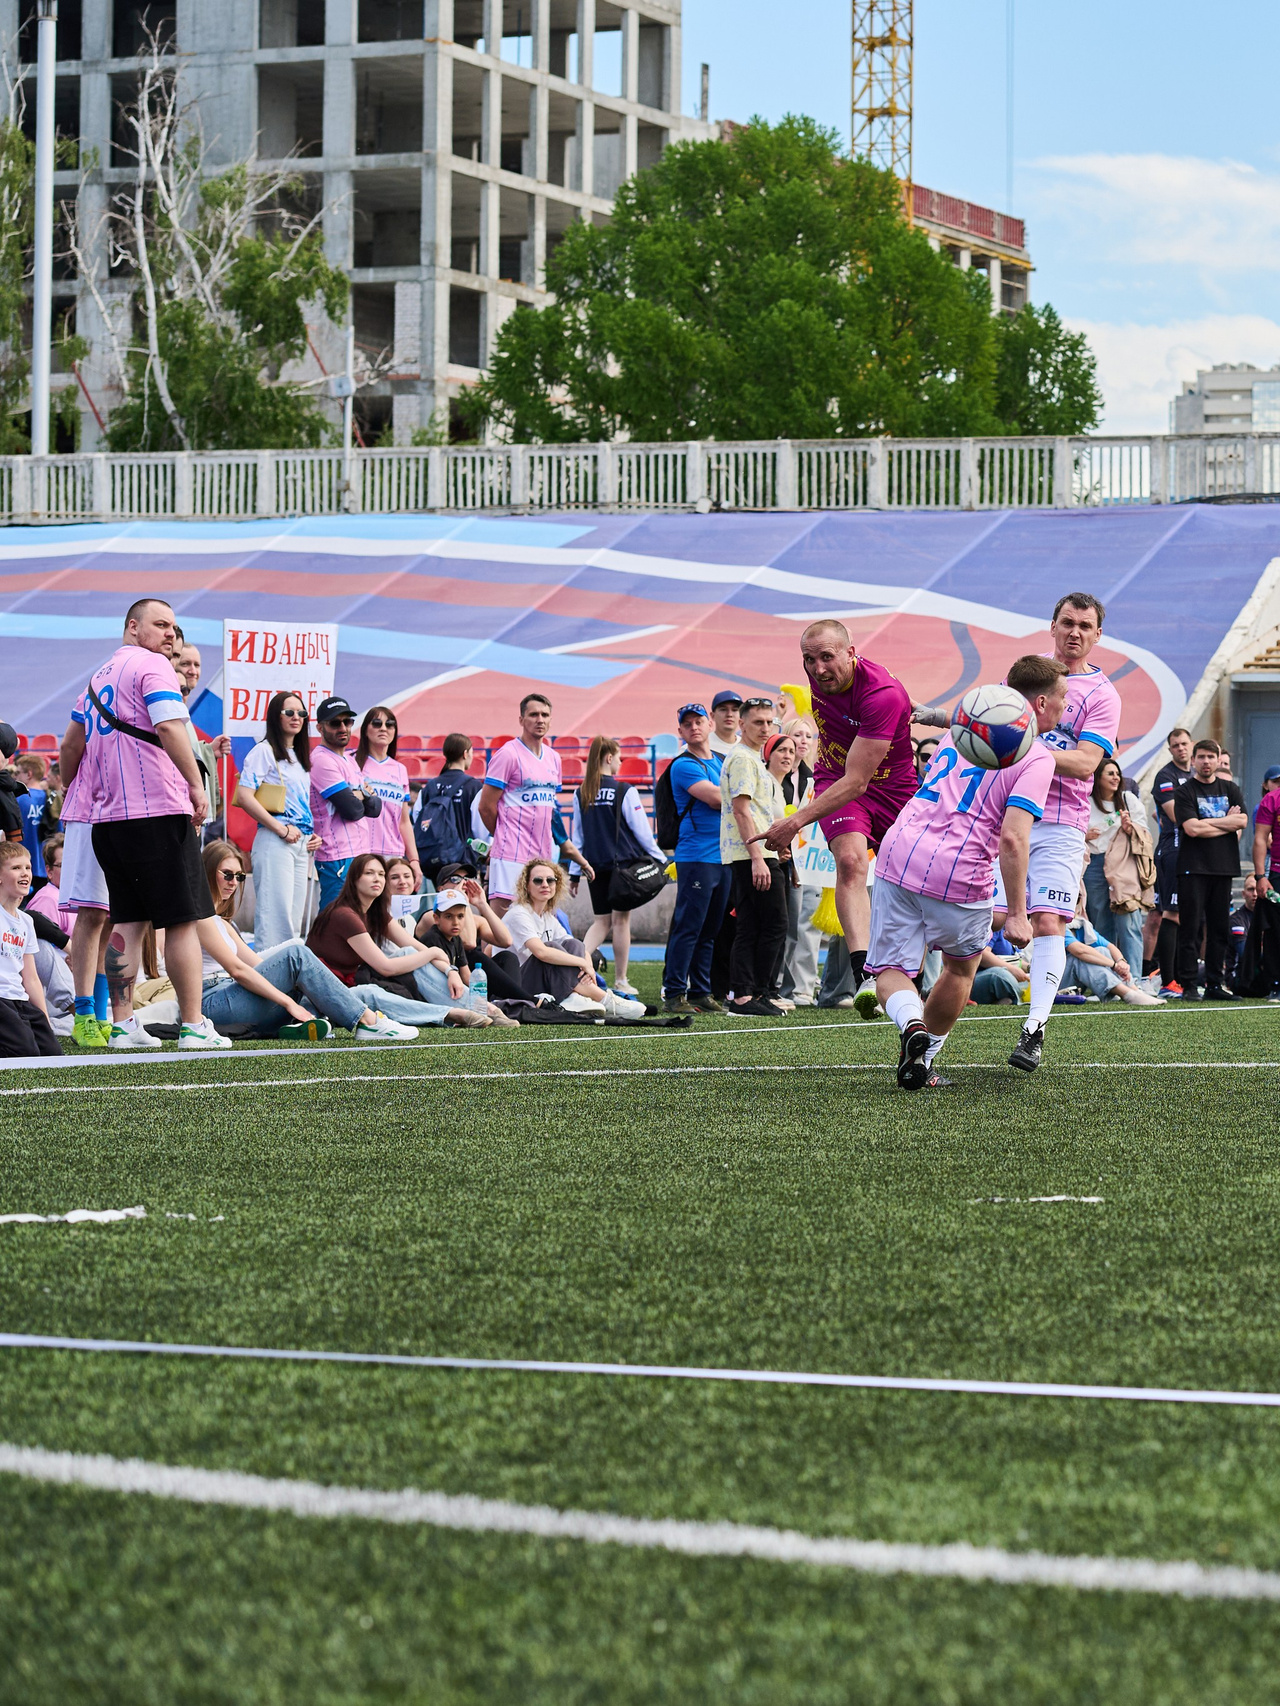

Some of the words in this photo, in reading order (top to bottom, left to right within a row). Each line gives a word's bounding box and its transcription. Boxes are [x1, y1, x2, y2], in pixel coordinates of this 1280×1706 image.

[227, 629, 331, 665] ИВАНЫЧ
[228, 682, 332, 722] ВПЁ
[915, 747, 988, 814] 21
[1048, 889, 1072, 903] ВТБ
